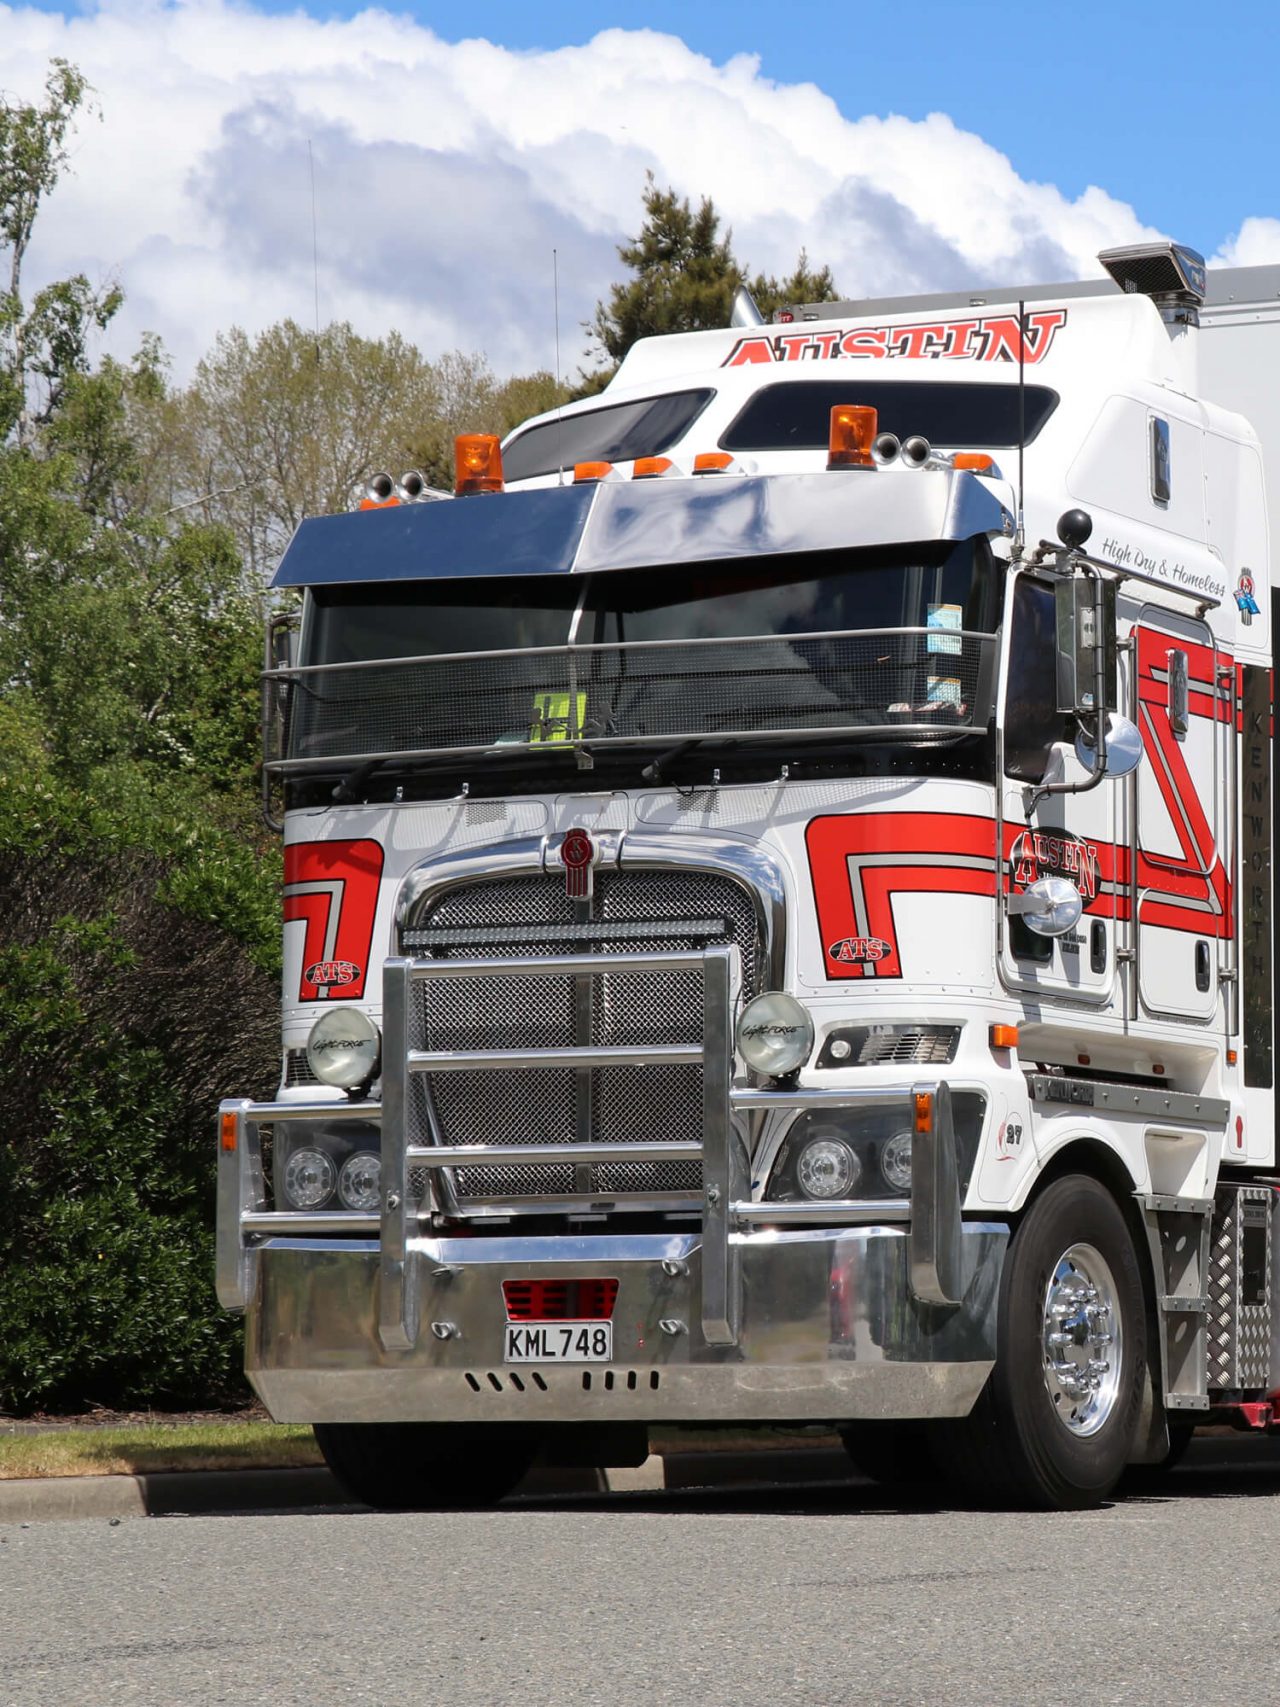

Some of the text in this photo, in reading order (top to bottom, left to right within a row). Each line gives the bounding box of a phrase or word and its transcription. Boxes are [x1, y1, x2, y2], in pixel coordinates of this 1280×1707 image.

[718, 308, 1068, 369] AUSTIN
[1102, 537, 1226, 597] High Dry & Homeless
[1014, 830, 1097, 899] AUSTIN
[836, 938, 884, 960] ATS
[311, 962, 354, 984] ATS
[508, 1328, 608, 1357] KML748
